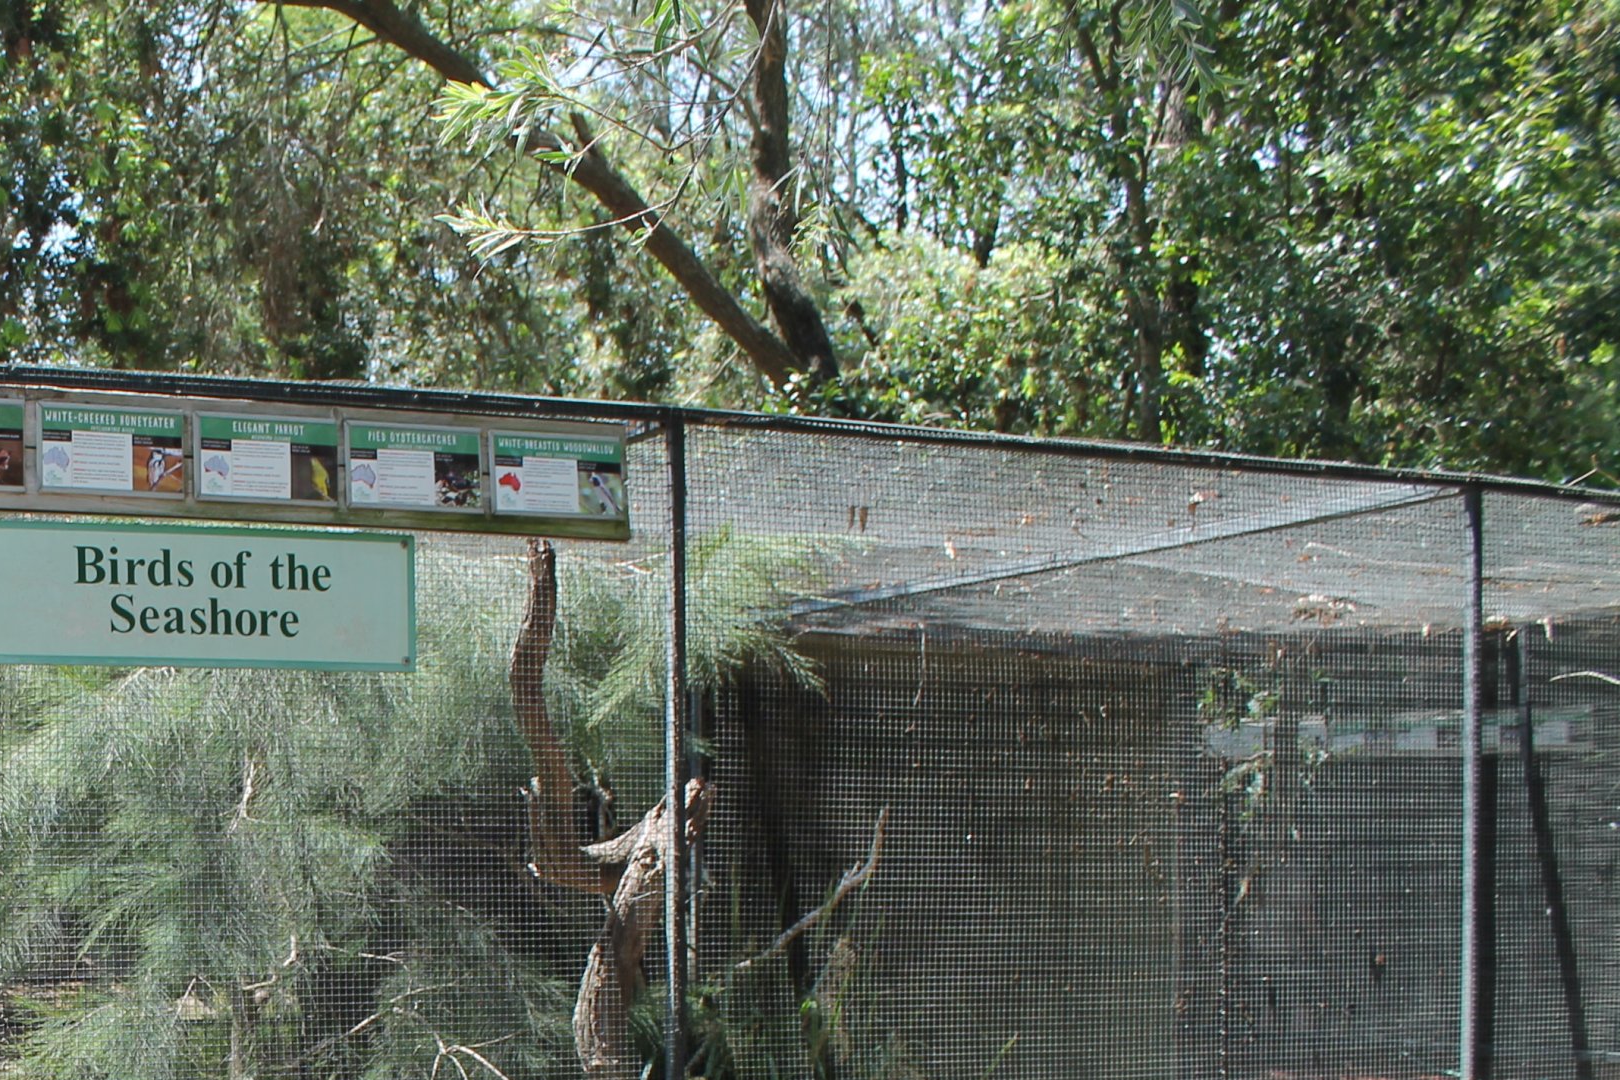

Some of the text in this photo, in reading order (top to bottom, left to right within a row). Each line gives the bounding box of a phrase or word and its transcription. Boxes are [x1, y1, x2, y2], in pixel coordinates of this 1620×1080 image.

[44, 410, 115, 426] WHITE-CHEEKED
[120, 414, 175, 429] HONEYEATER
[232, 420, 304, 436] ELEGANT PARROT
[367, 431, 457, 446] PIED OYSTERCATCHER
[498, 437, 559, 452] WHITE-BREASTED
[73, 545, 332, 592] Birds of the
[109, 593, 300, 638] Seashore
